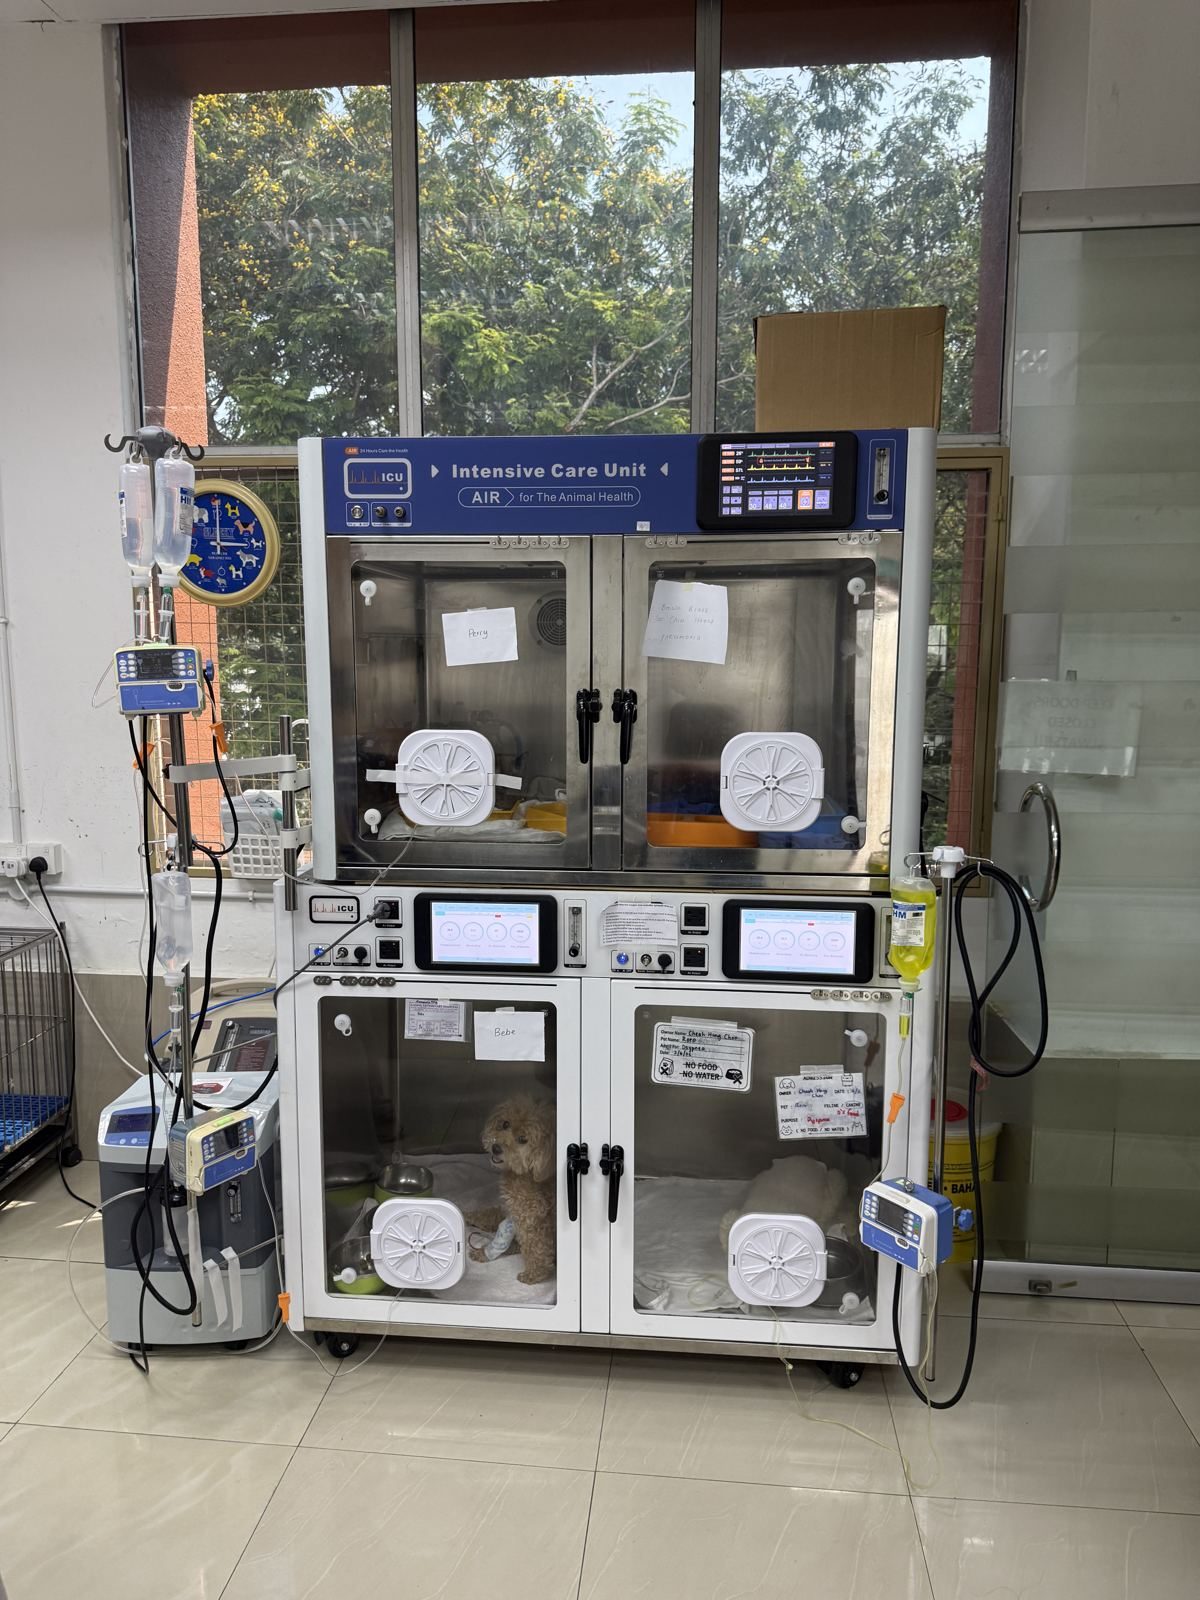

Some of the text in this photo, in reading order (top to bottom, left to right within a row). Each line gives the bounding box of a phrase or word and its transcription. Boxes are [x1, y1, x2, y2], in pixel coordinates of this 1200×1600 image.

[452, 462, 646, 478] Intensive Care Unit
[381, 472, 403, 482] ICU
[472, 491, 634, 504] AIR for The Animal Health
[468, 628, 489, 640] Perry
[494, 1027, 516, 1037] Bebe
[685, 1061, 718, 1071] NO FOOD
[682, 1070, 720, 1081] NO WATER
